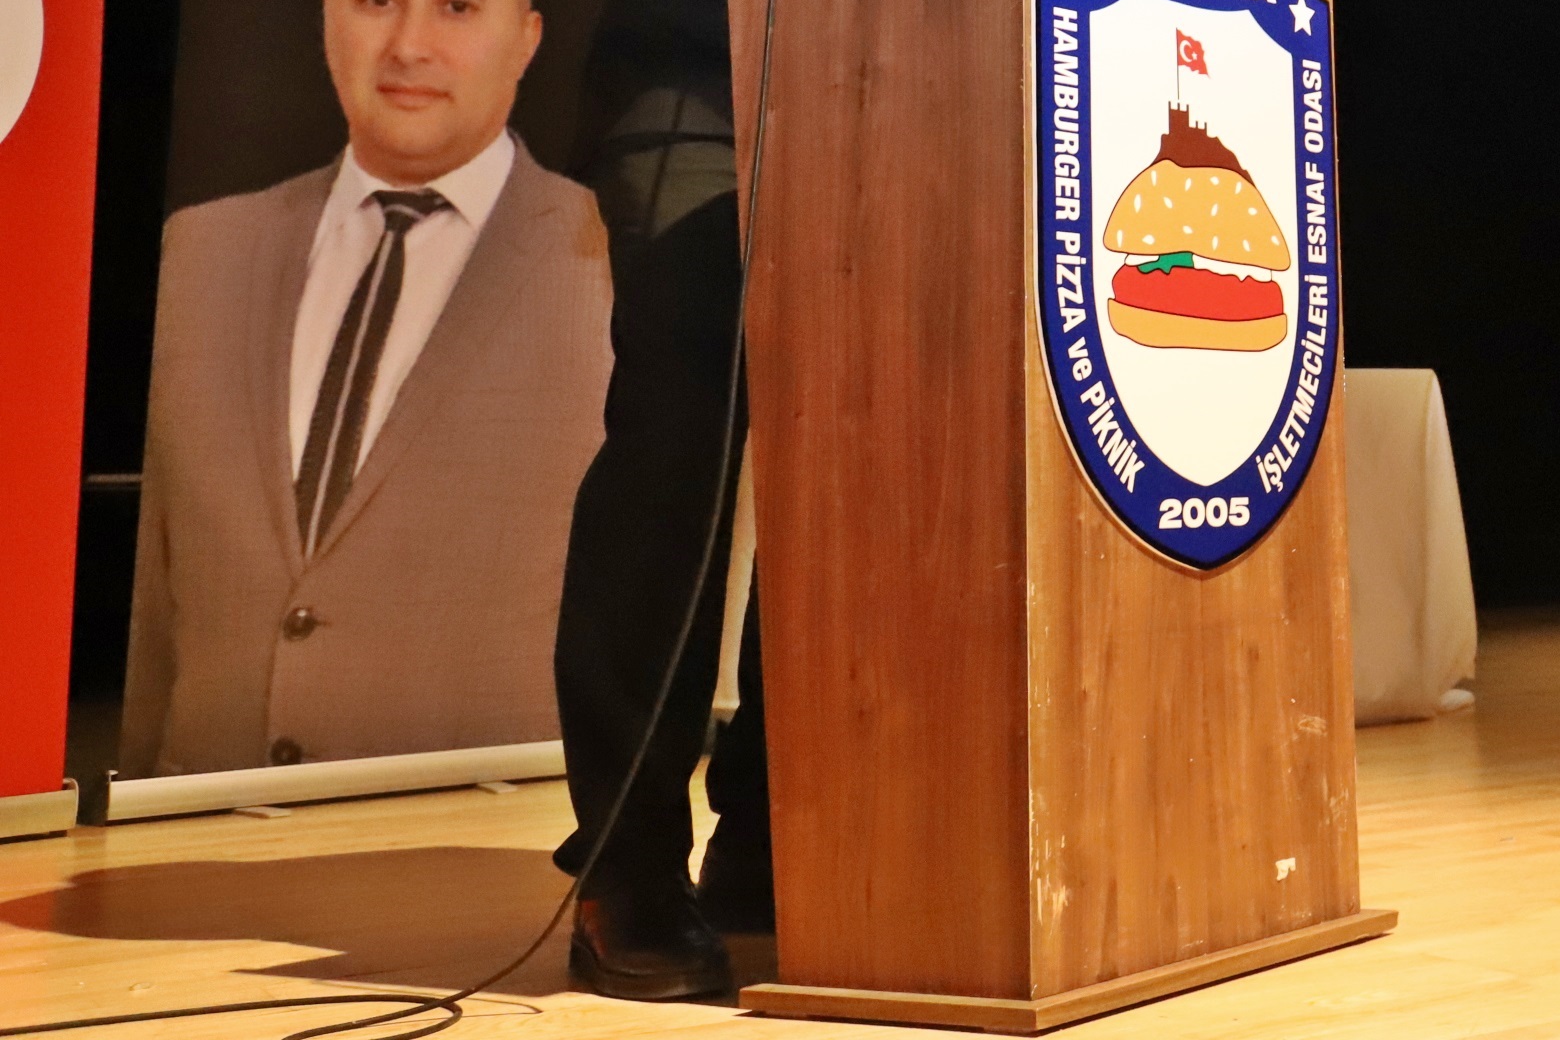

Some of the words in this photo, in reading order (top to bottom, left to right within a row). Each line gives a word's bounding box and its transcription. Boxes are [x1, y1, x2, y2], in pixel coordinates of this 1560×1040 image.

[1052, 5, 1079, 222] HAMBURGER
[1302, 59, 1324, 154] ODASI
[1305, 162, 1327, 264] ESNAF
[1054, 231, 1086, 335] PİZZA
[1067, 337, 1093, 381] ve
[1255, 274, 1329, 494] İŞLETMECİLERİ
[1079, 380, 1145, 493] PİKNİK
[1159, 497, 1250, 529] 2005
